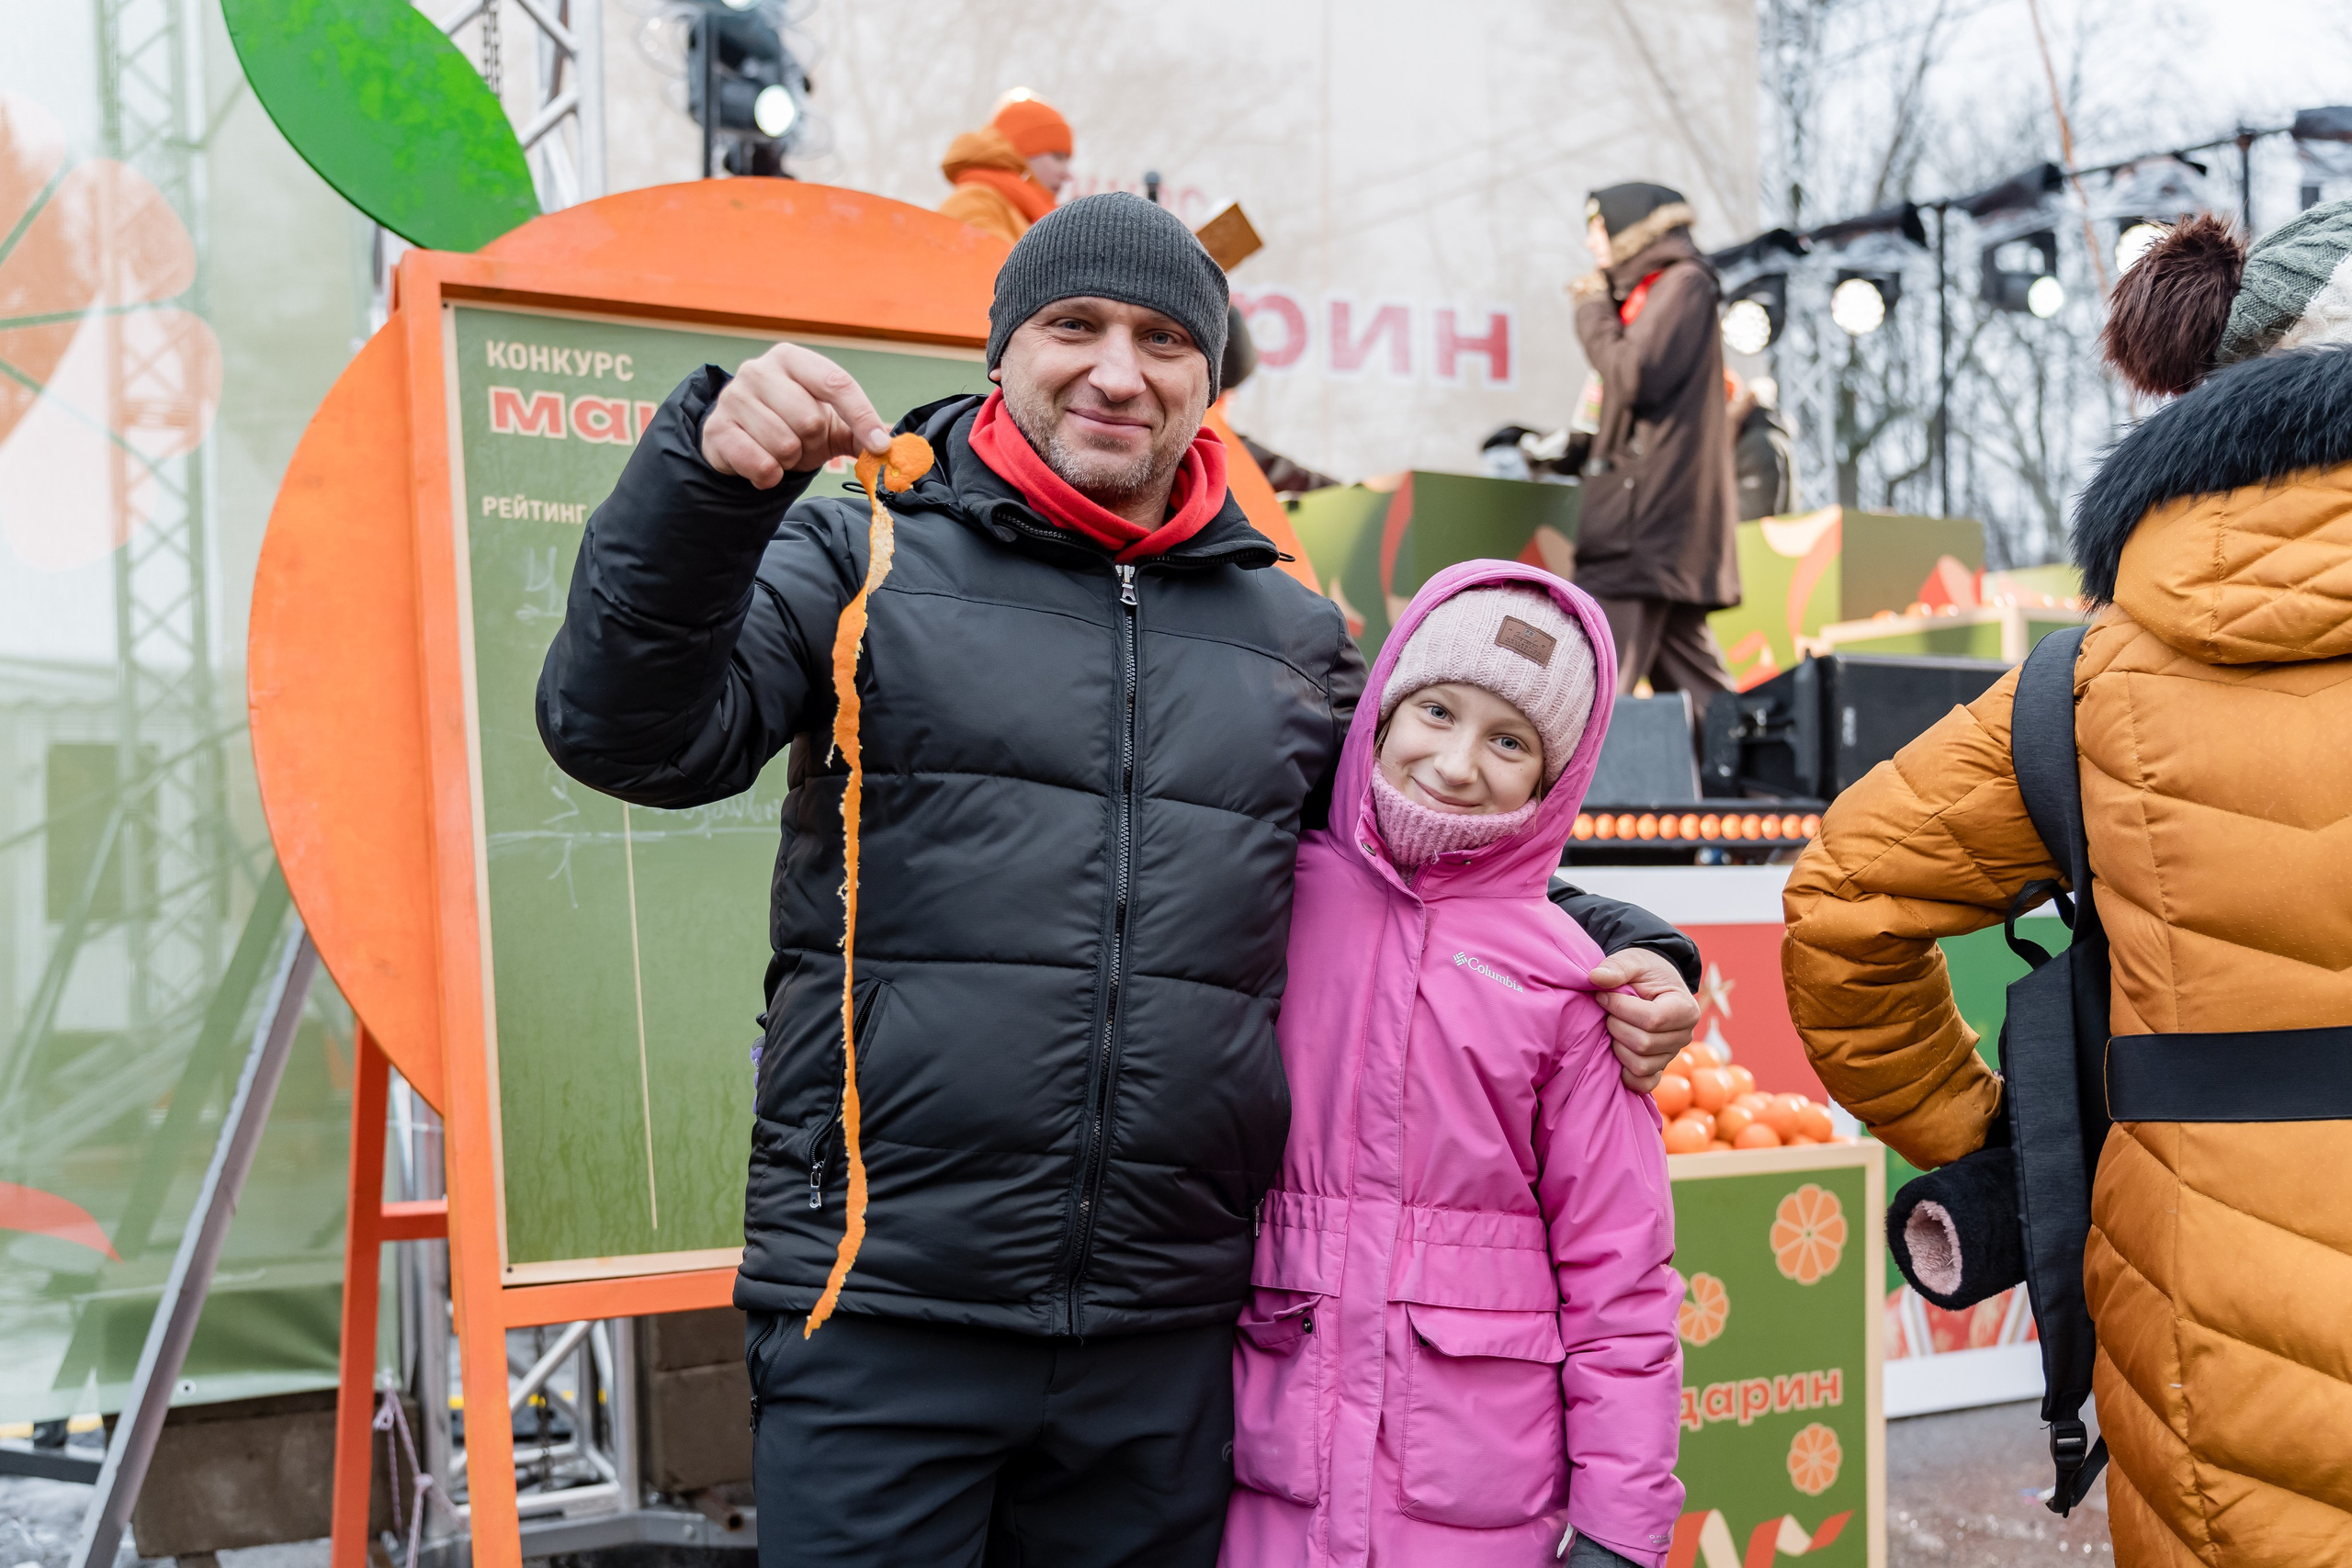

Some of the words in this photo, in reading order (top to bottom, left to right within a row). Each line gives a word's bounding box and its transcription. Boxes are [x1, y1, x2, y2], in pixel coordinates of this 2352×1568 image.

[485, 340, 635, 382] КОНКУРС
[481, 493, 588, 525] РЕЙТИНГ
[1467, 957, 1524, 993] Columbia
